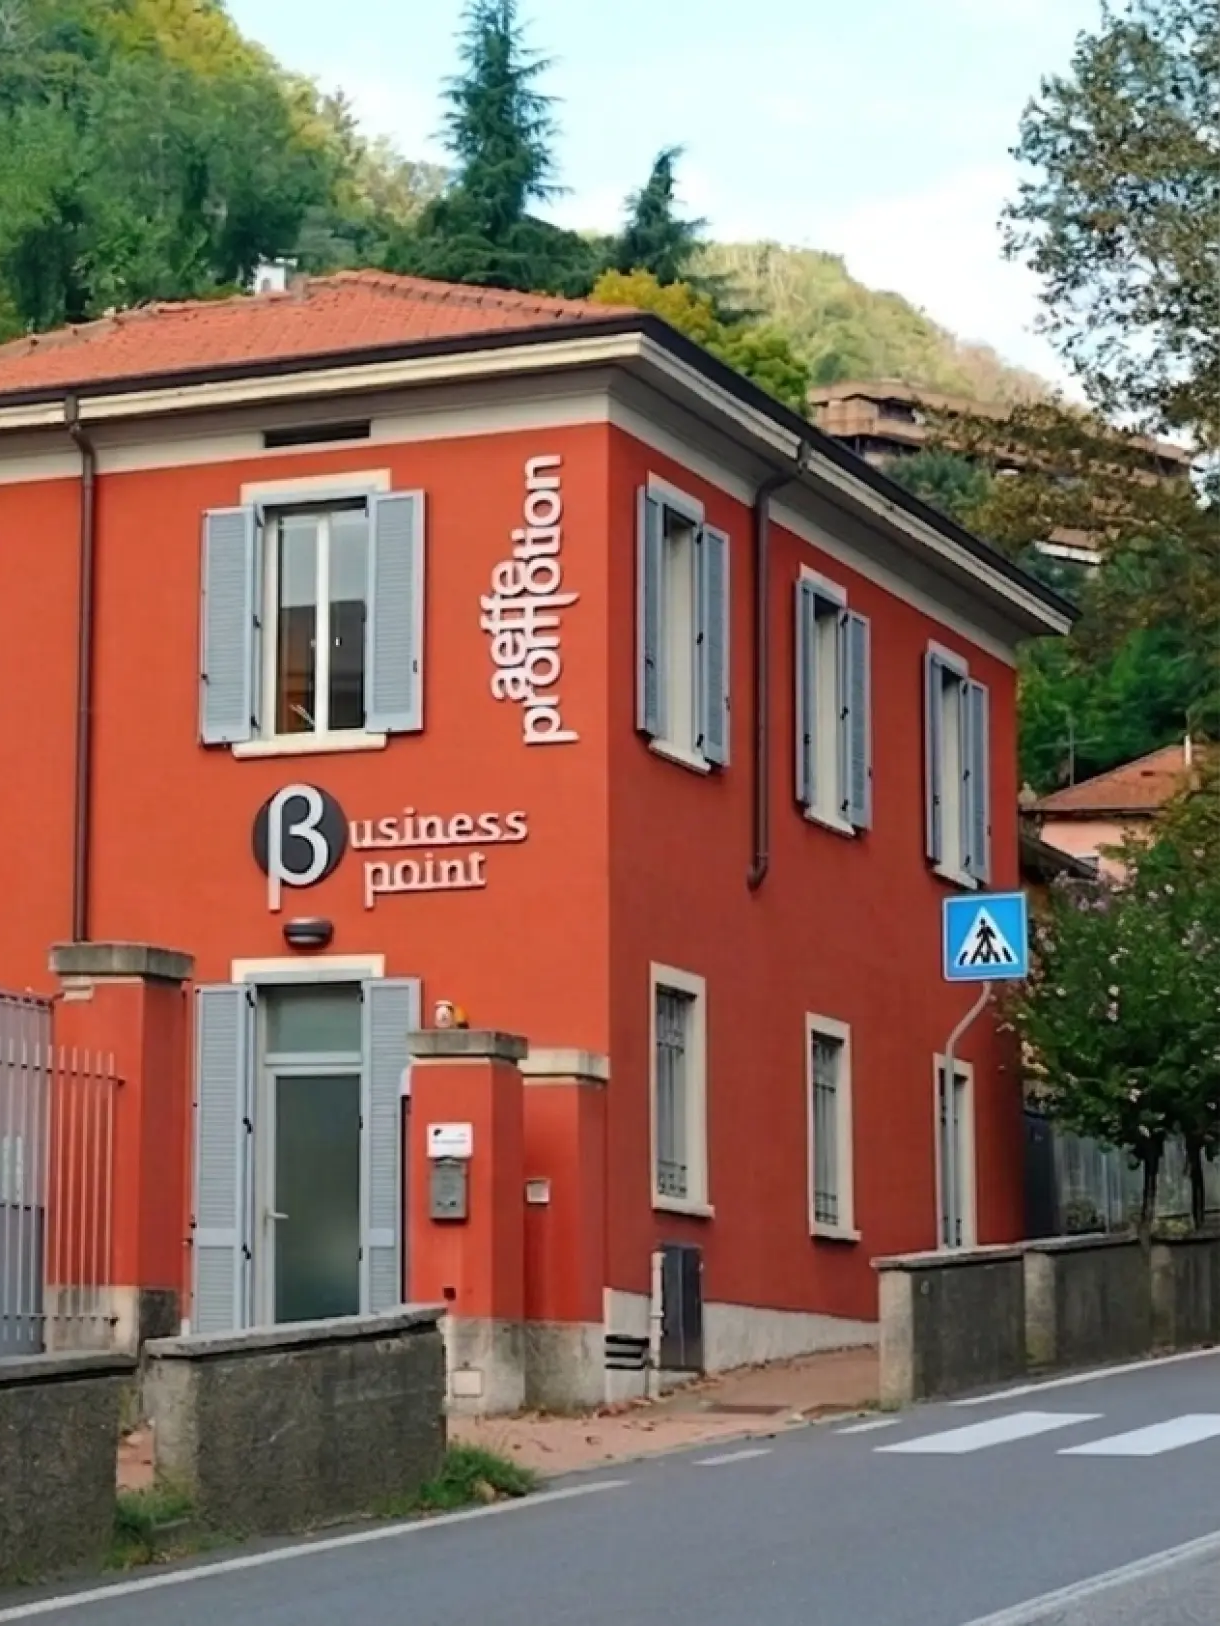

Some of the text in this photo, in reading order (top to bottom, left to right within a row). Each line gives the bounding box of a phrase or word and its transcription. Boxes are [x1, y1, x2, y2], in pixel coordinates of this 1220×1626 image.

[479, 559, 527, 701] aeffe
[511, 454, 579, 744] promotion
[363, 851, 487, 910] point
